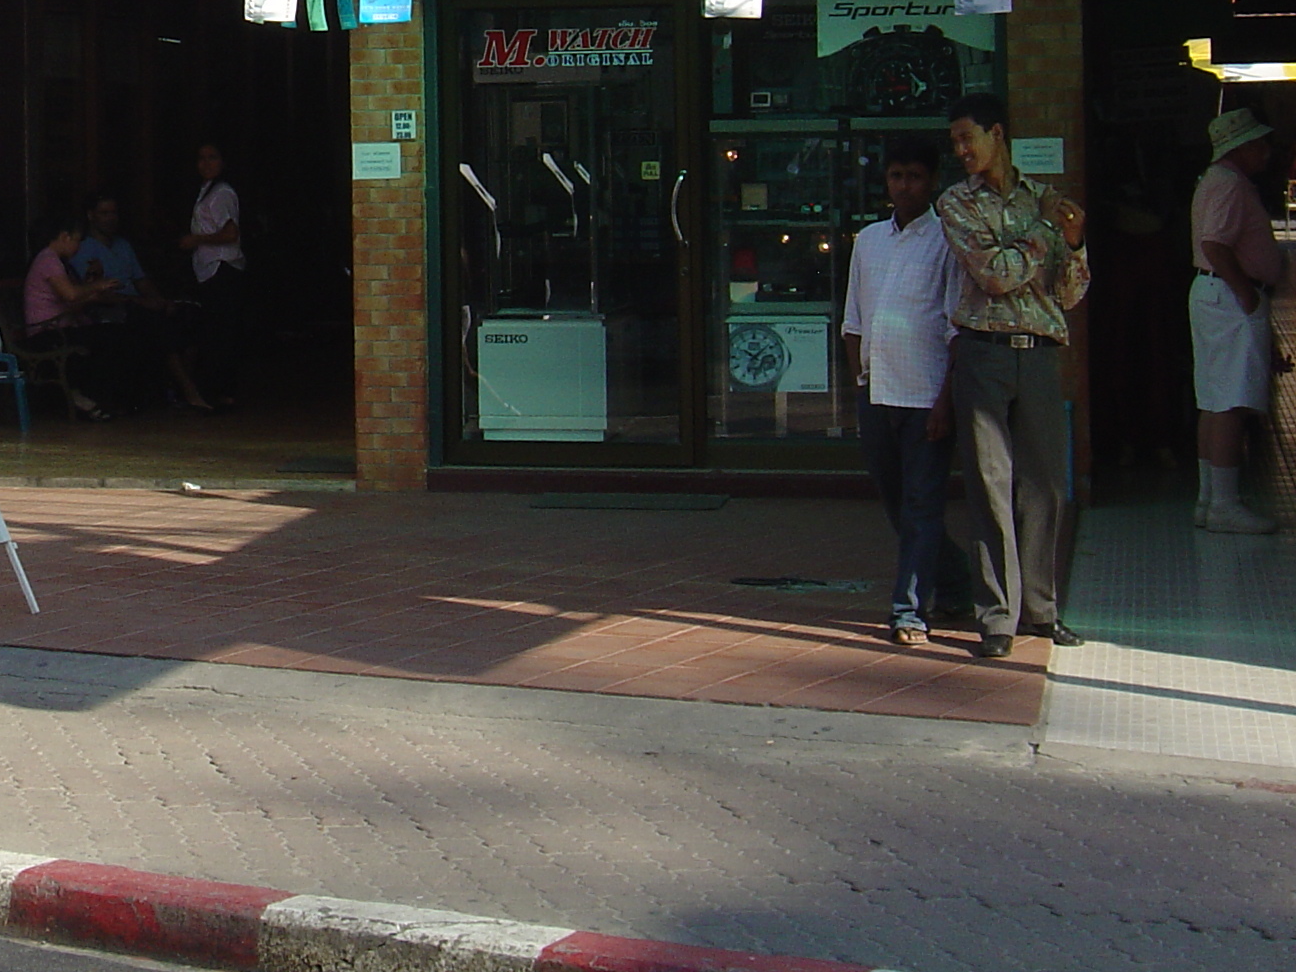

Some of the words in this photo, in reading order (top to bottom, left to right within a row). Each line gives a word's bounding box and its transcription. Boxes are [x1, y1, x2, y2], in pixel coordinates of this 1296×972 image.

[829, 2, 956, 20] Sportur
[548, 28, 657, 51] WATCH
[546, 53, 654, 67] ORIGINAL
[394, 112, 412, 121] OPEN
[485, 333, 529, 344] SEIKO
